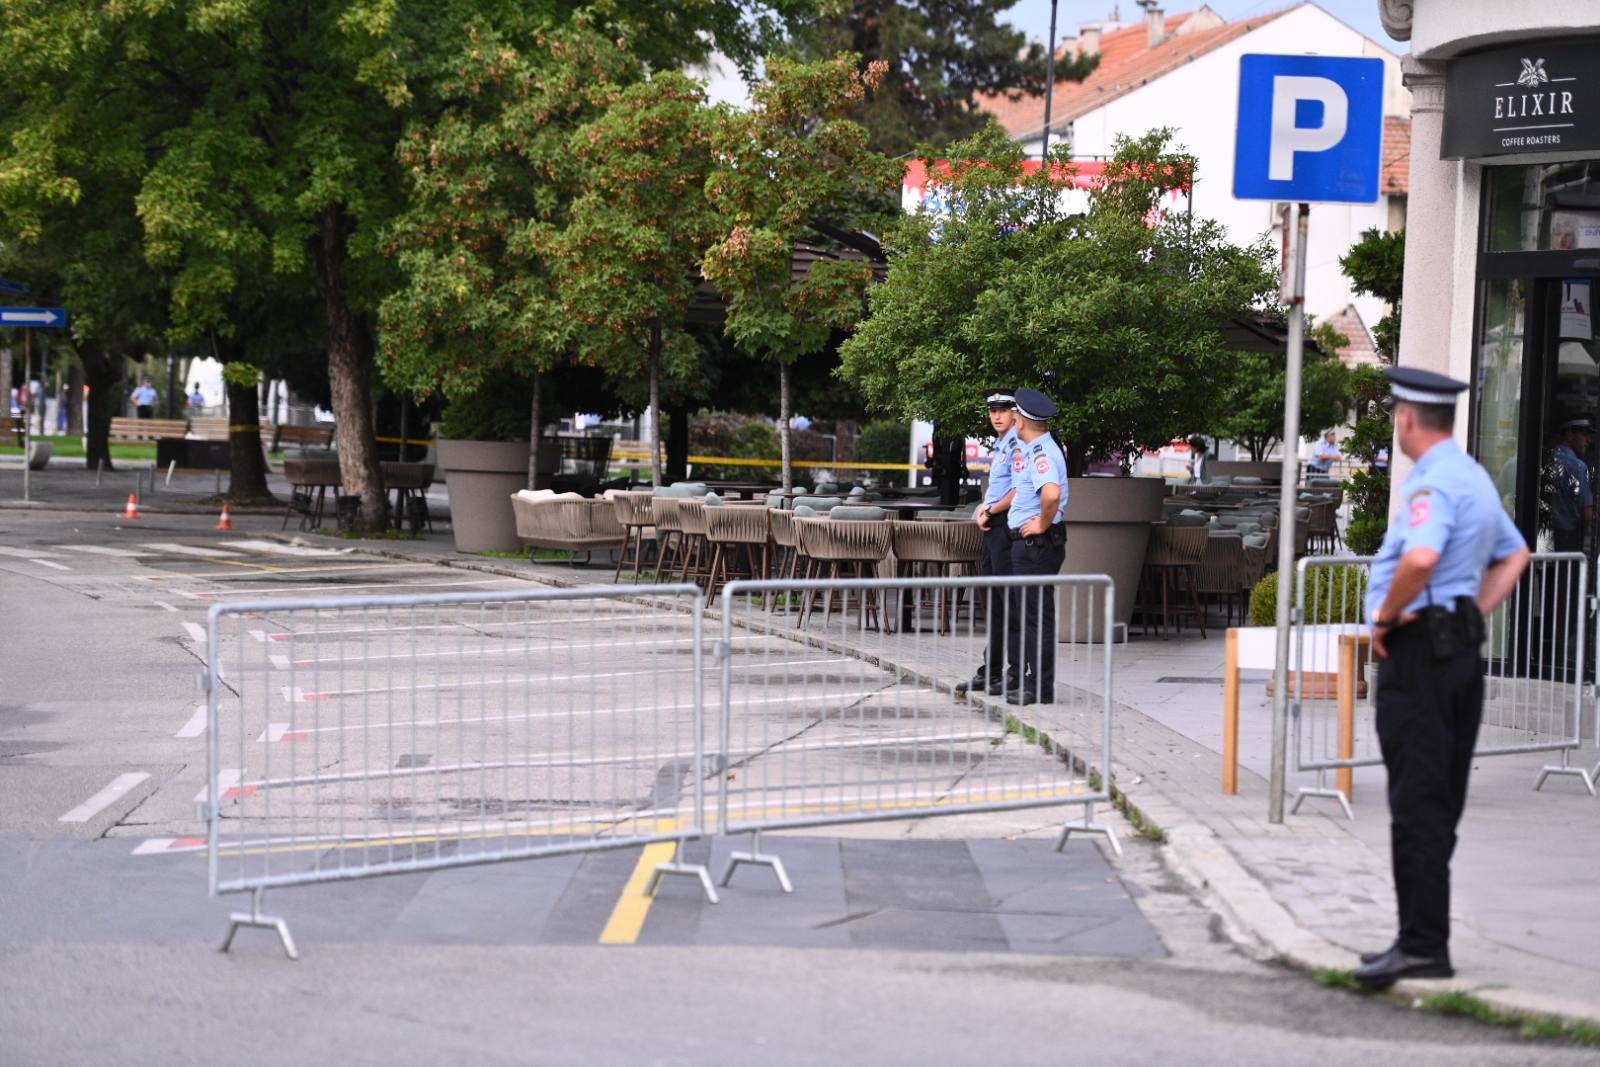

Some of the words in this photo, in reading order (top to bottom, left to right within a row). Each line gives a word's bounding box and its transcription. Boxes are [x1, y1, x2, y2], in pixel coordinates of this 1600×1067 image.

[1494, 91, 1574, 119] ELIXIR
[1268, 75, 1349, 181] P
[1501, 137, 1525, 147] COFFEE
[1526, 135, 1561, 145] ROASTERS
